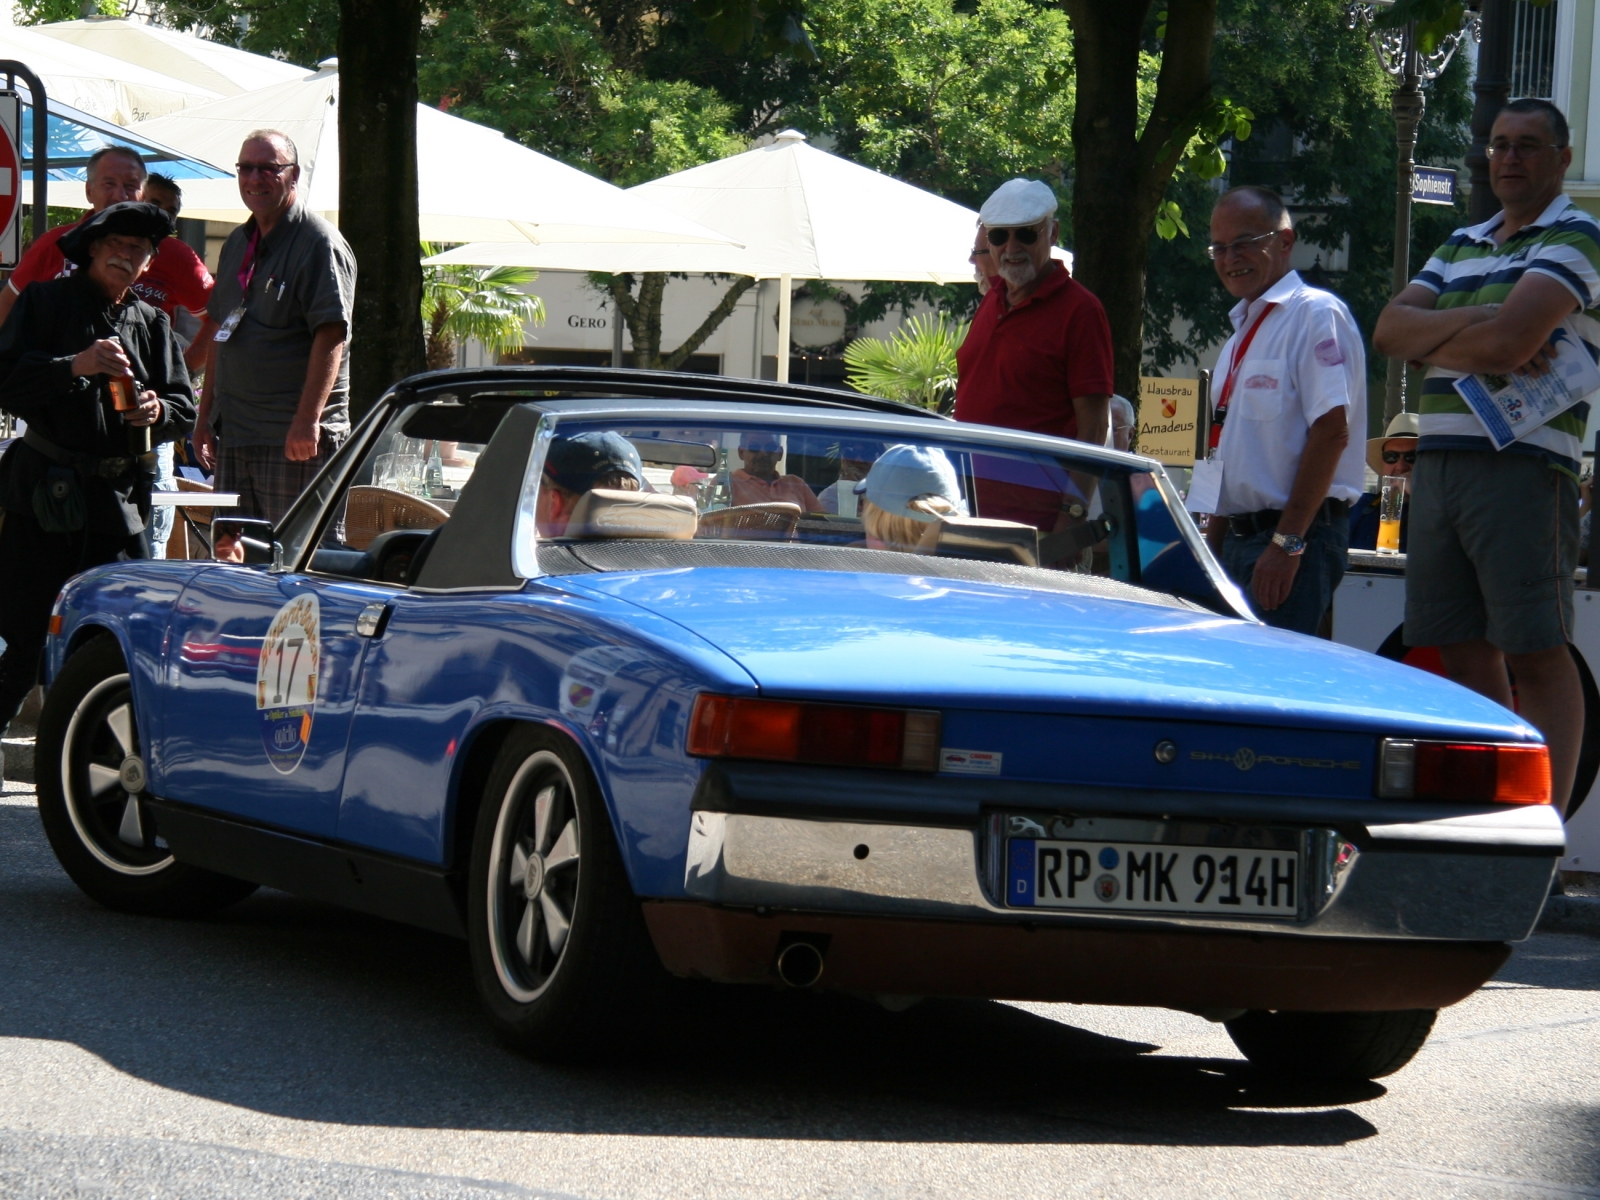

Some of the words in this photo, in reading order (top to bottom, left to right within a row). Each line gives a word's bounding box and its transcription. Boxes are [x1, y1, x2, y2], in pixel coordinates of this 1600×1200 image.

[132, 107, 150, 122] Bar
[1414, 173, 1452, 197] Sophienstr.
[567, 314, 607, 329] GERO
[1146, 382, 1192, 396] Hausbräu
[1140, 420, 1194, 434] Amadeus
[1141, 445, 1191, 457] Restaurant
[275, 638, 304, 705] 17
[1257, 755, 1361, 769] PORSCHE
[1038, 847, 1091, 898] RP
[1126, 851, 1179, 903] MK
[1192, 854, 1295, 908] 914H
[1017, 879, 1027, 894] D
